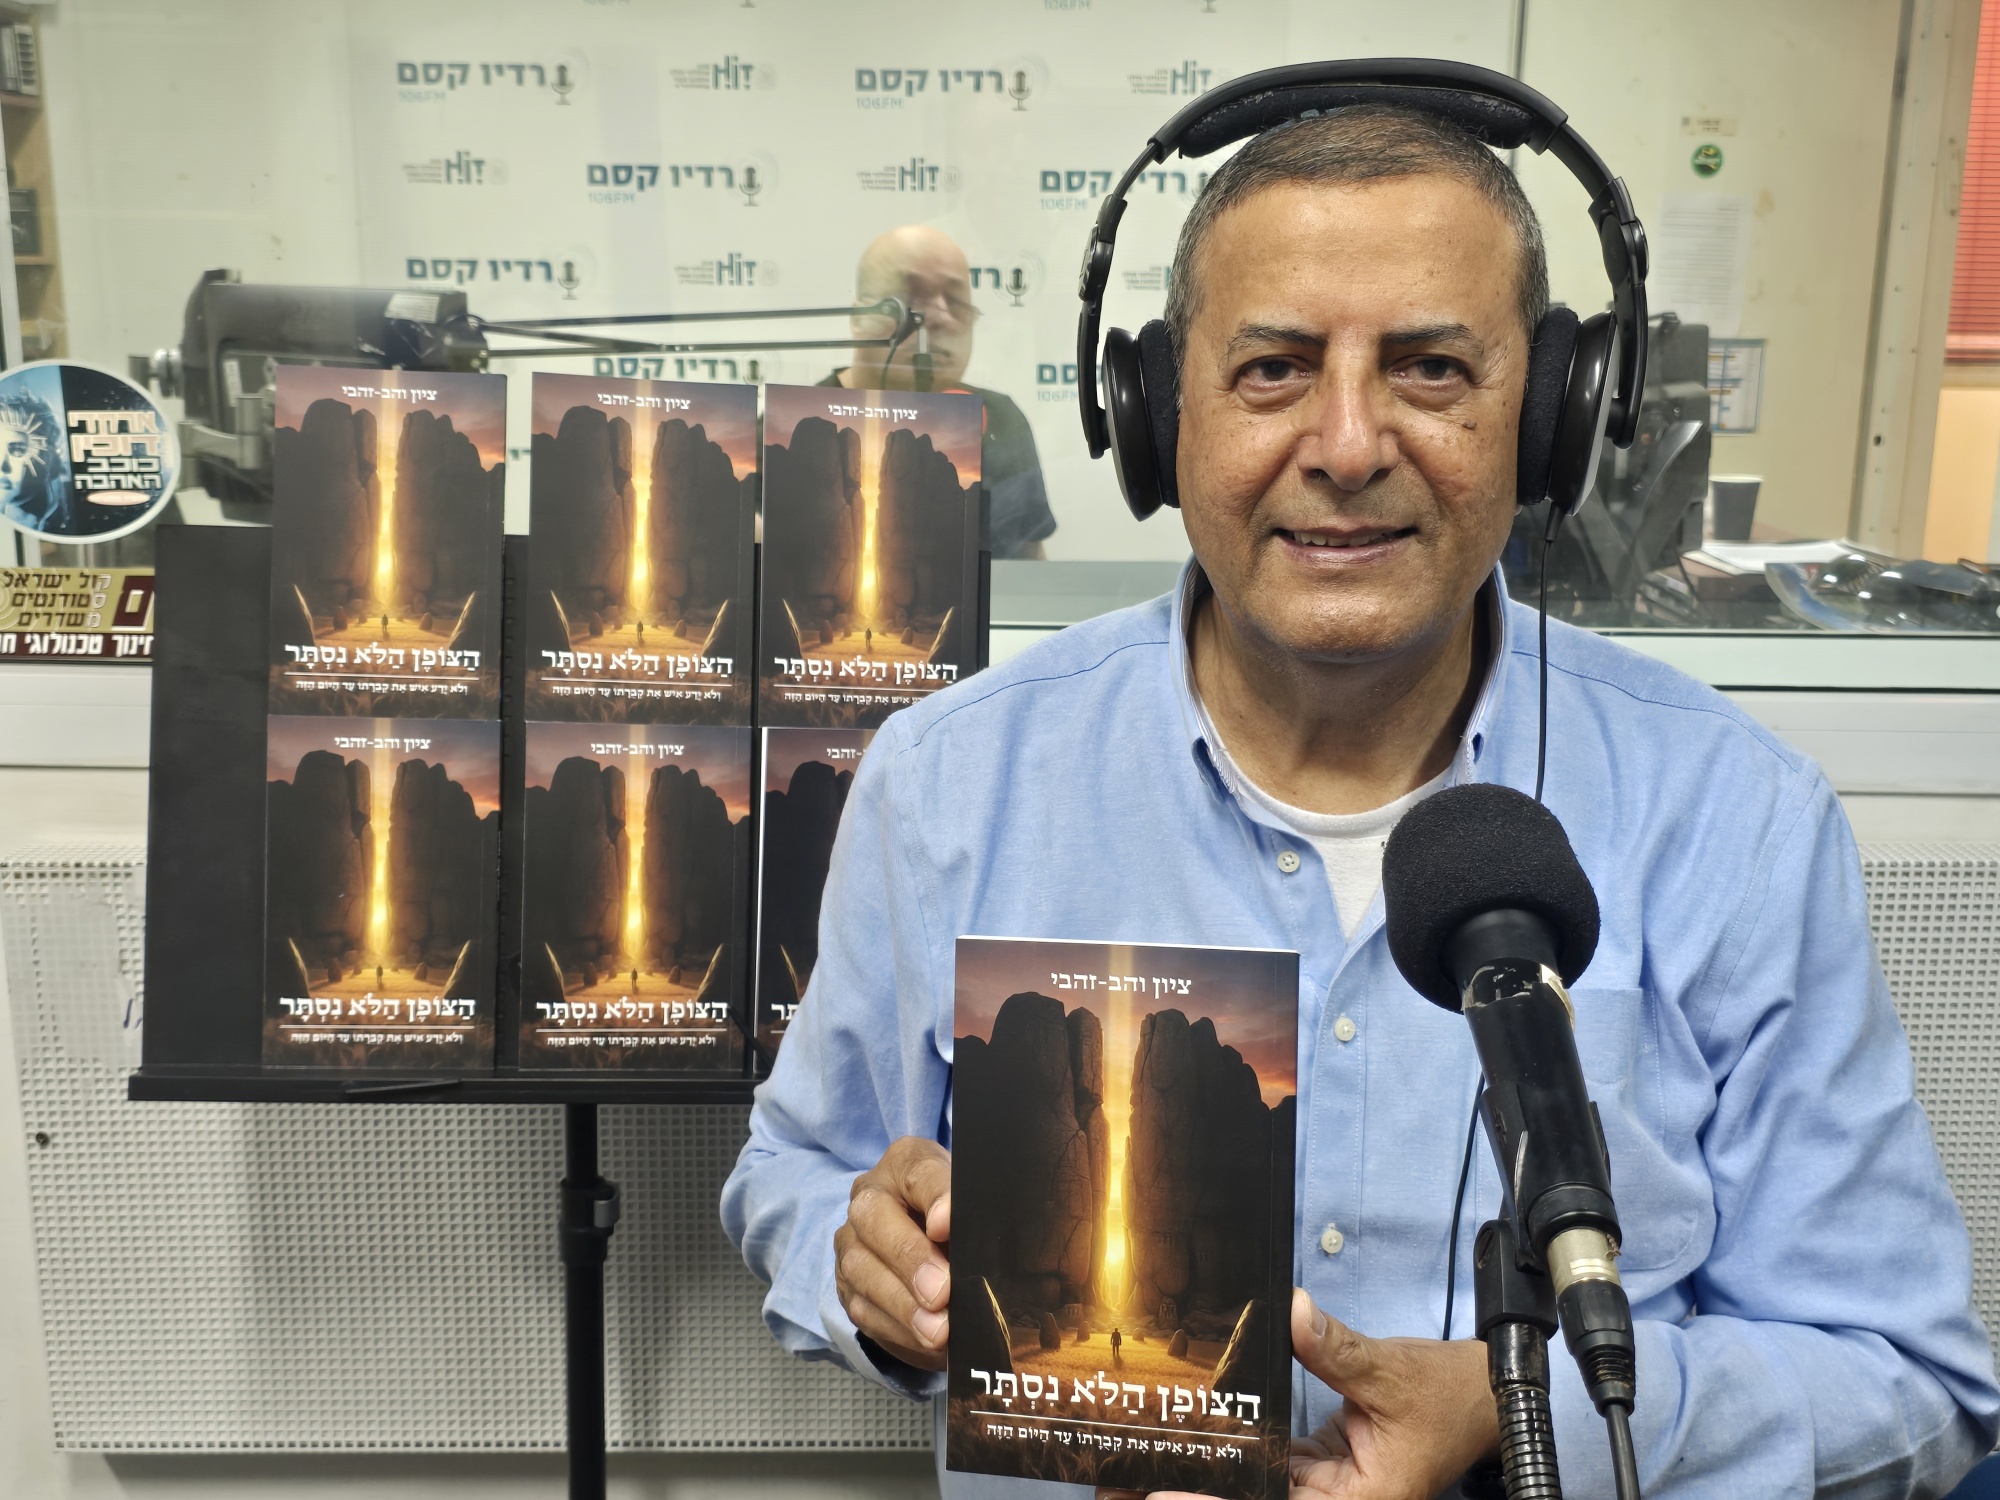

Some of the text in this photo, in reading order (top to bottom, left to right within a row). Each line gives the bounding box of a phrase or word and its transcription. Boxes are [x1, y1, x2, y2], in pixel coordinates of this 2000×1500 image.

[397, 62, 545, 90] רדיו קסם
[855, 69, 1003, 97] רדיו קסם
[587, 165, 734, 192] רדיו קסם
[1040, 170, 1112, 198] קסם
[406, 259, 553, 286] רדיו קסם
[594, 357, 738, 380] רדיו קסם
[342, 385, 438, 403] ציון והב-זהבי
[597, 393, 691, 412] ציון והב-זהבי
[827, 404, 918, 423] ציון והב-זהבי
[87, 457, 161, 473] כוכב
[74, 473, 162, 490] האהבה
[3, 571, 111, 592] קול ישראל
[11, 592, 107, 609] סטודנטים
[18, 612, 101, 628] משדרים
[24, 631, 104, 655] טכנולוגי
[335, 736, 432, 753] ציון והב-זהבי
[591, 742, 685, 759] ציון והב-זהבי
[1050, 972, 1192, 1000] ציון והב-זהבי
